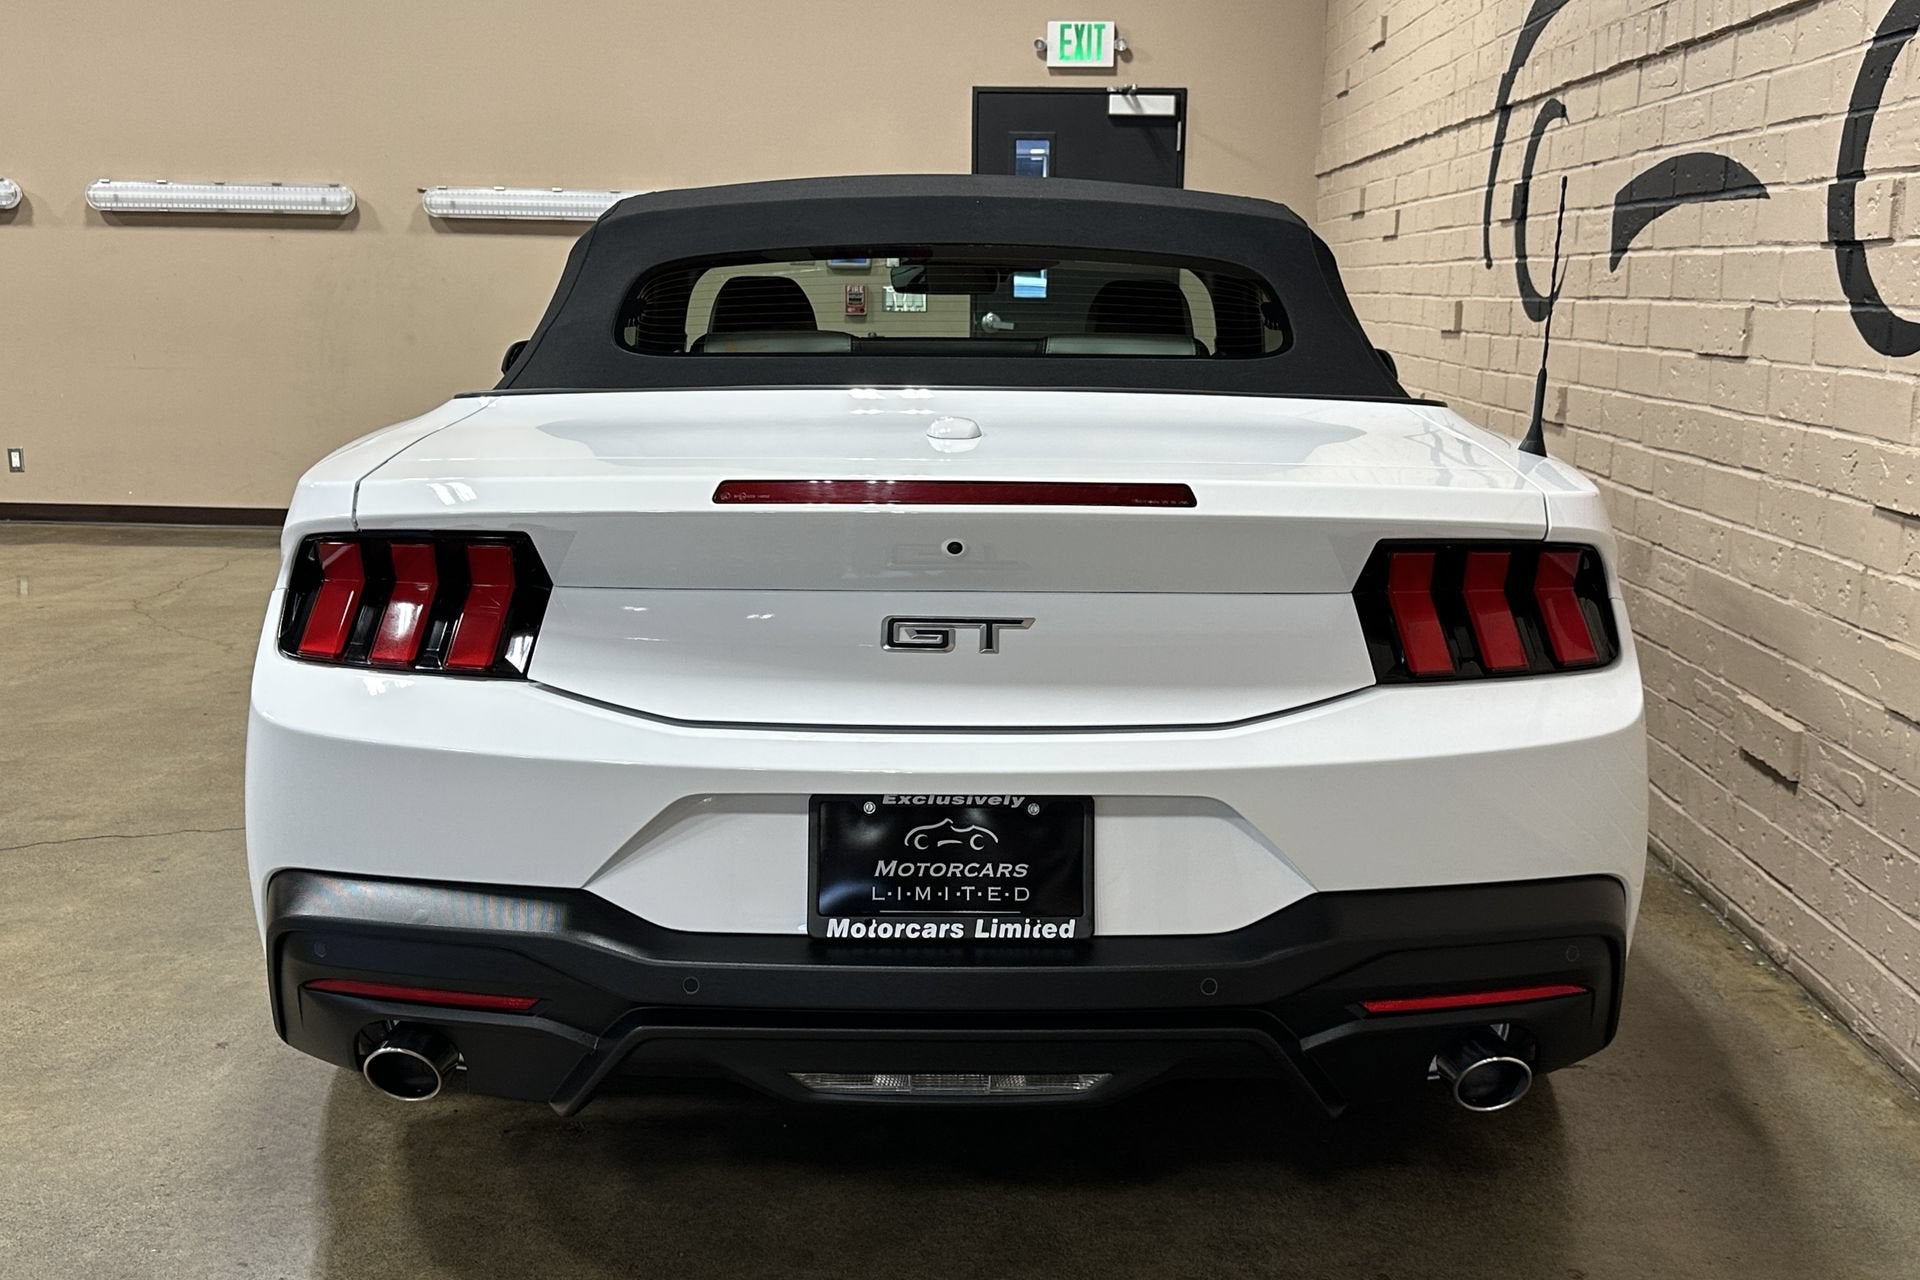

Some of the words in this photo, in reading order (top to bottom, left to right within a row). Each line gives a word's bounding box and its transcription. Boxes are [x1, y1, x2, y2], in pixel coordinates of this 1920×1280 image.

[1059, 23, 1106, 61] EXIT
[880, 615, 1036, 654] GT
[882, 794, 1025, 808] Exclusively
[874, 860, 1029, 878] MOTORCARS
[826, 918, 964, 939] Motorcars
[974, 918, 1076, 939] Limited
